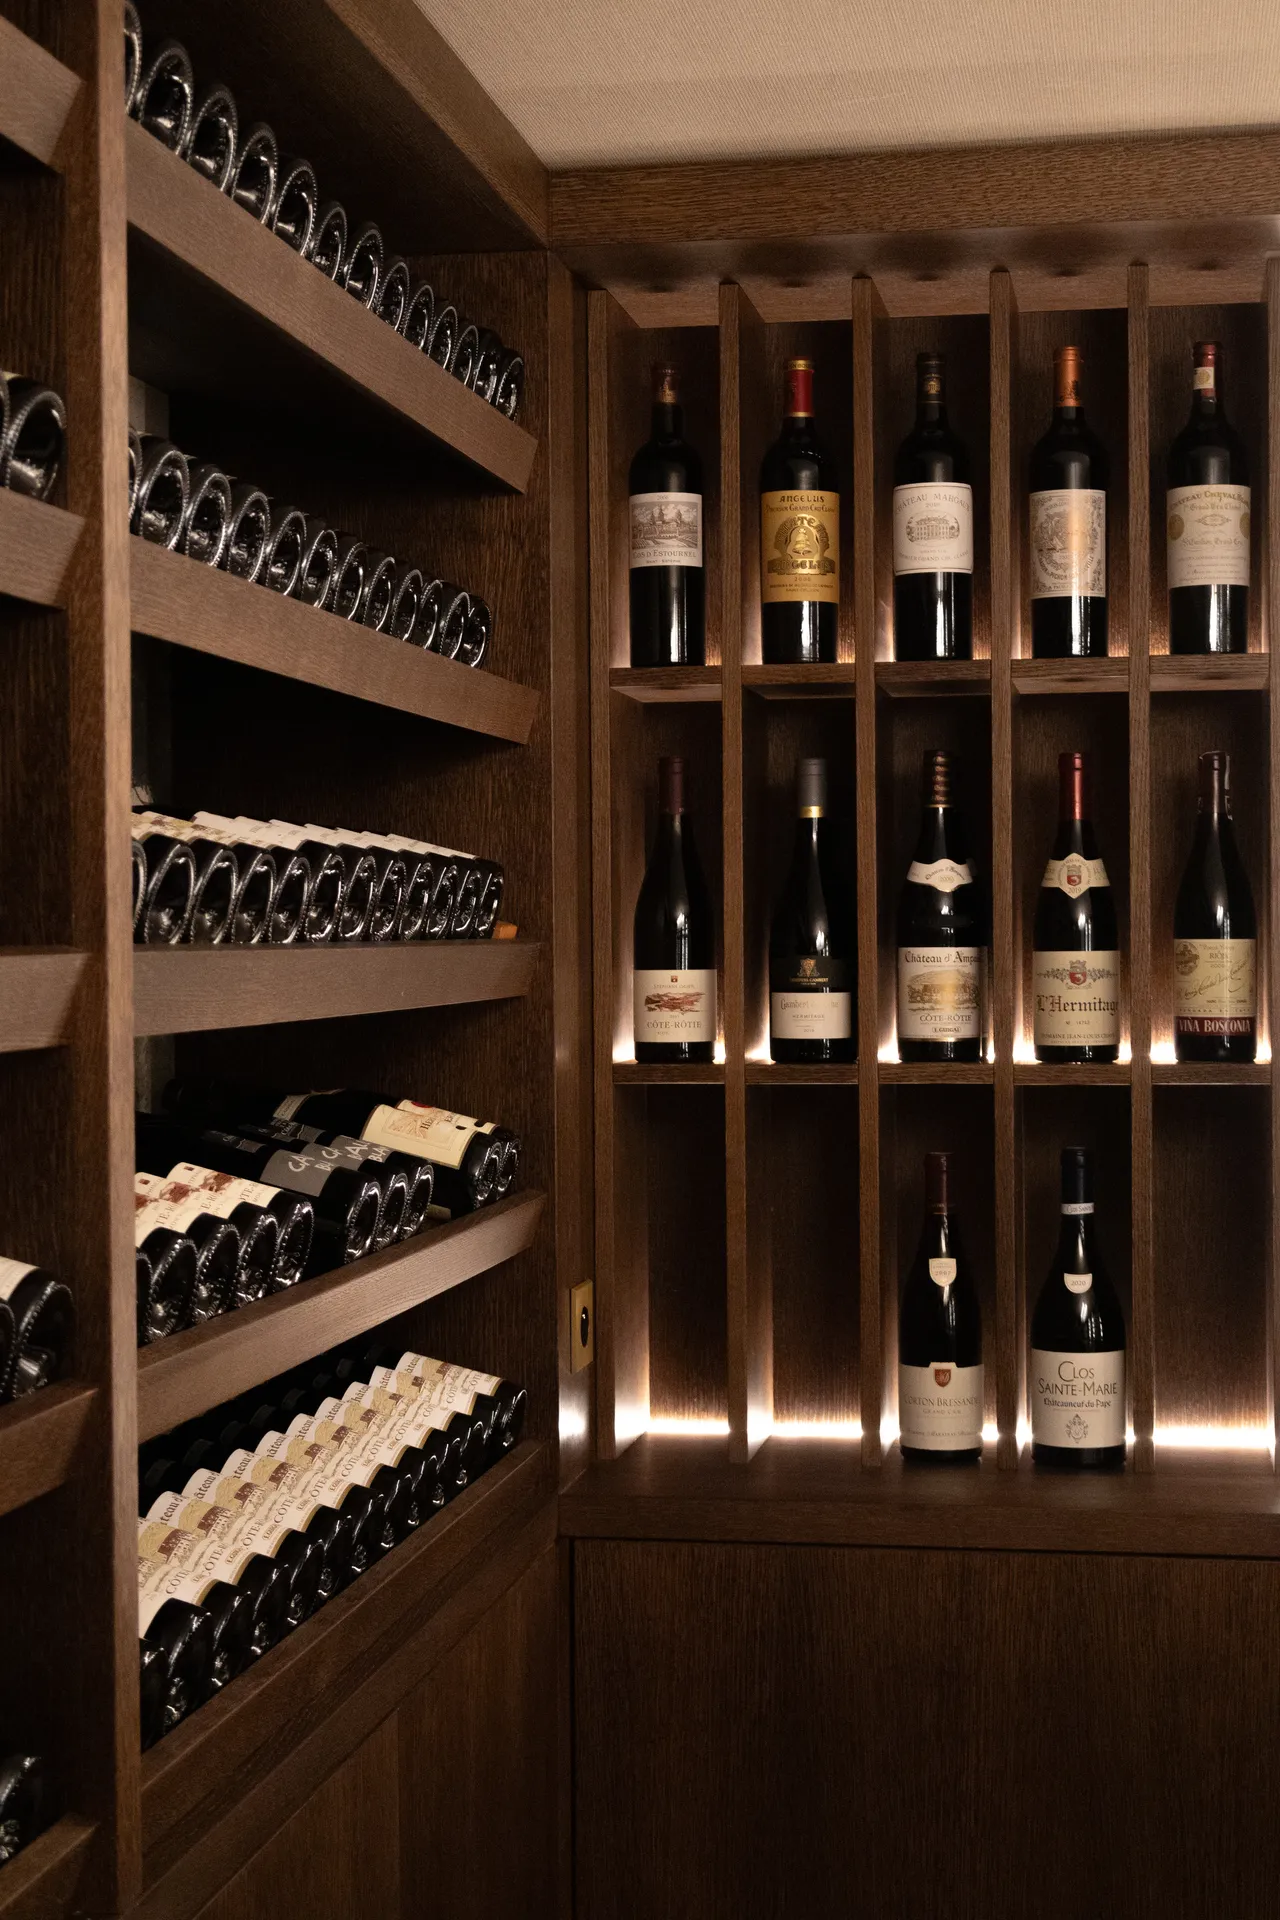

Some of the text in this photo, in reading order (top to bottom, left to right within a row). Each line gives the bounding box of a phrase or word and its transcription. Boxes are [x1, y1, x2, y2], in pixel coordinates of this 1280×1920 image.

[779, 495, 825, 503] ANGELUS
[904, 950, 942, 963] Château
[920, 1013, 972, 1022] CÔTE-RÔTIE
[646, 1019, 702, 1030] CÔTE-RÔTIE
[1179, 1016, 1251, 1033] VIÑA BOSCONIA
[1058, 1360, 1095, 1383] CLOS
[1038, 1377, 1118, 1397] SAINTE-MARIE
[1043, 1397, 1112, 1409] Châteauneuf du Pape
